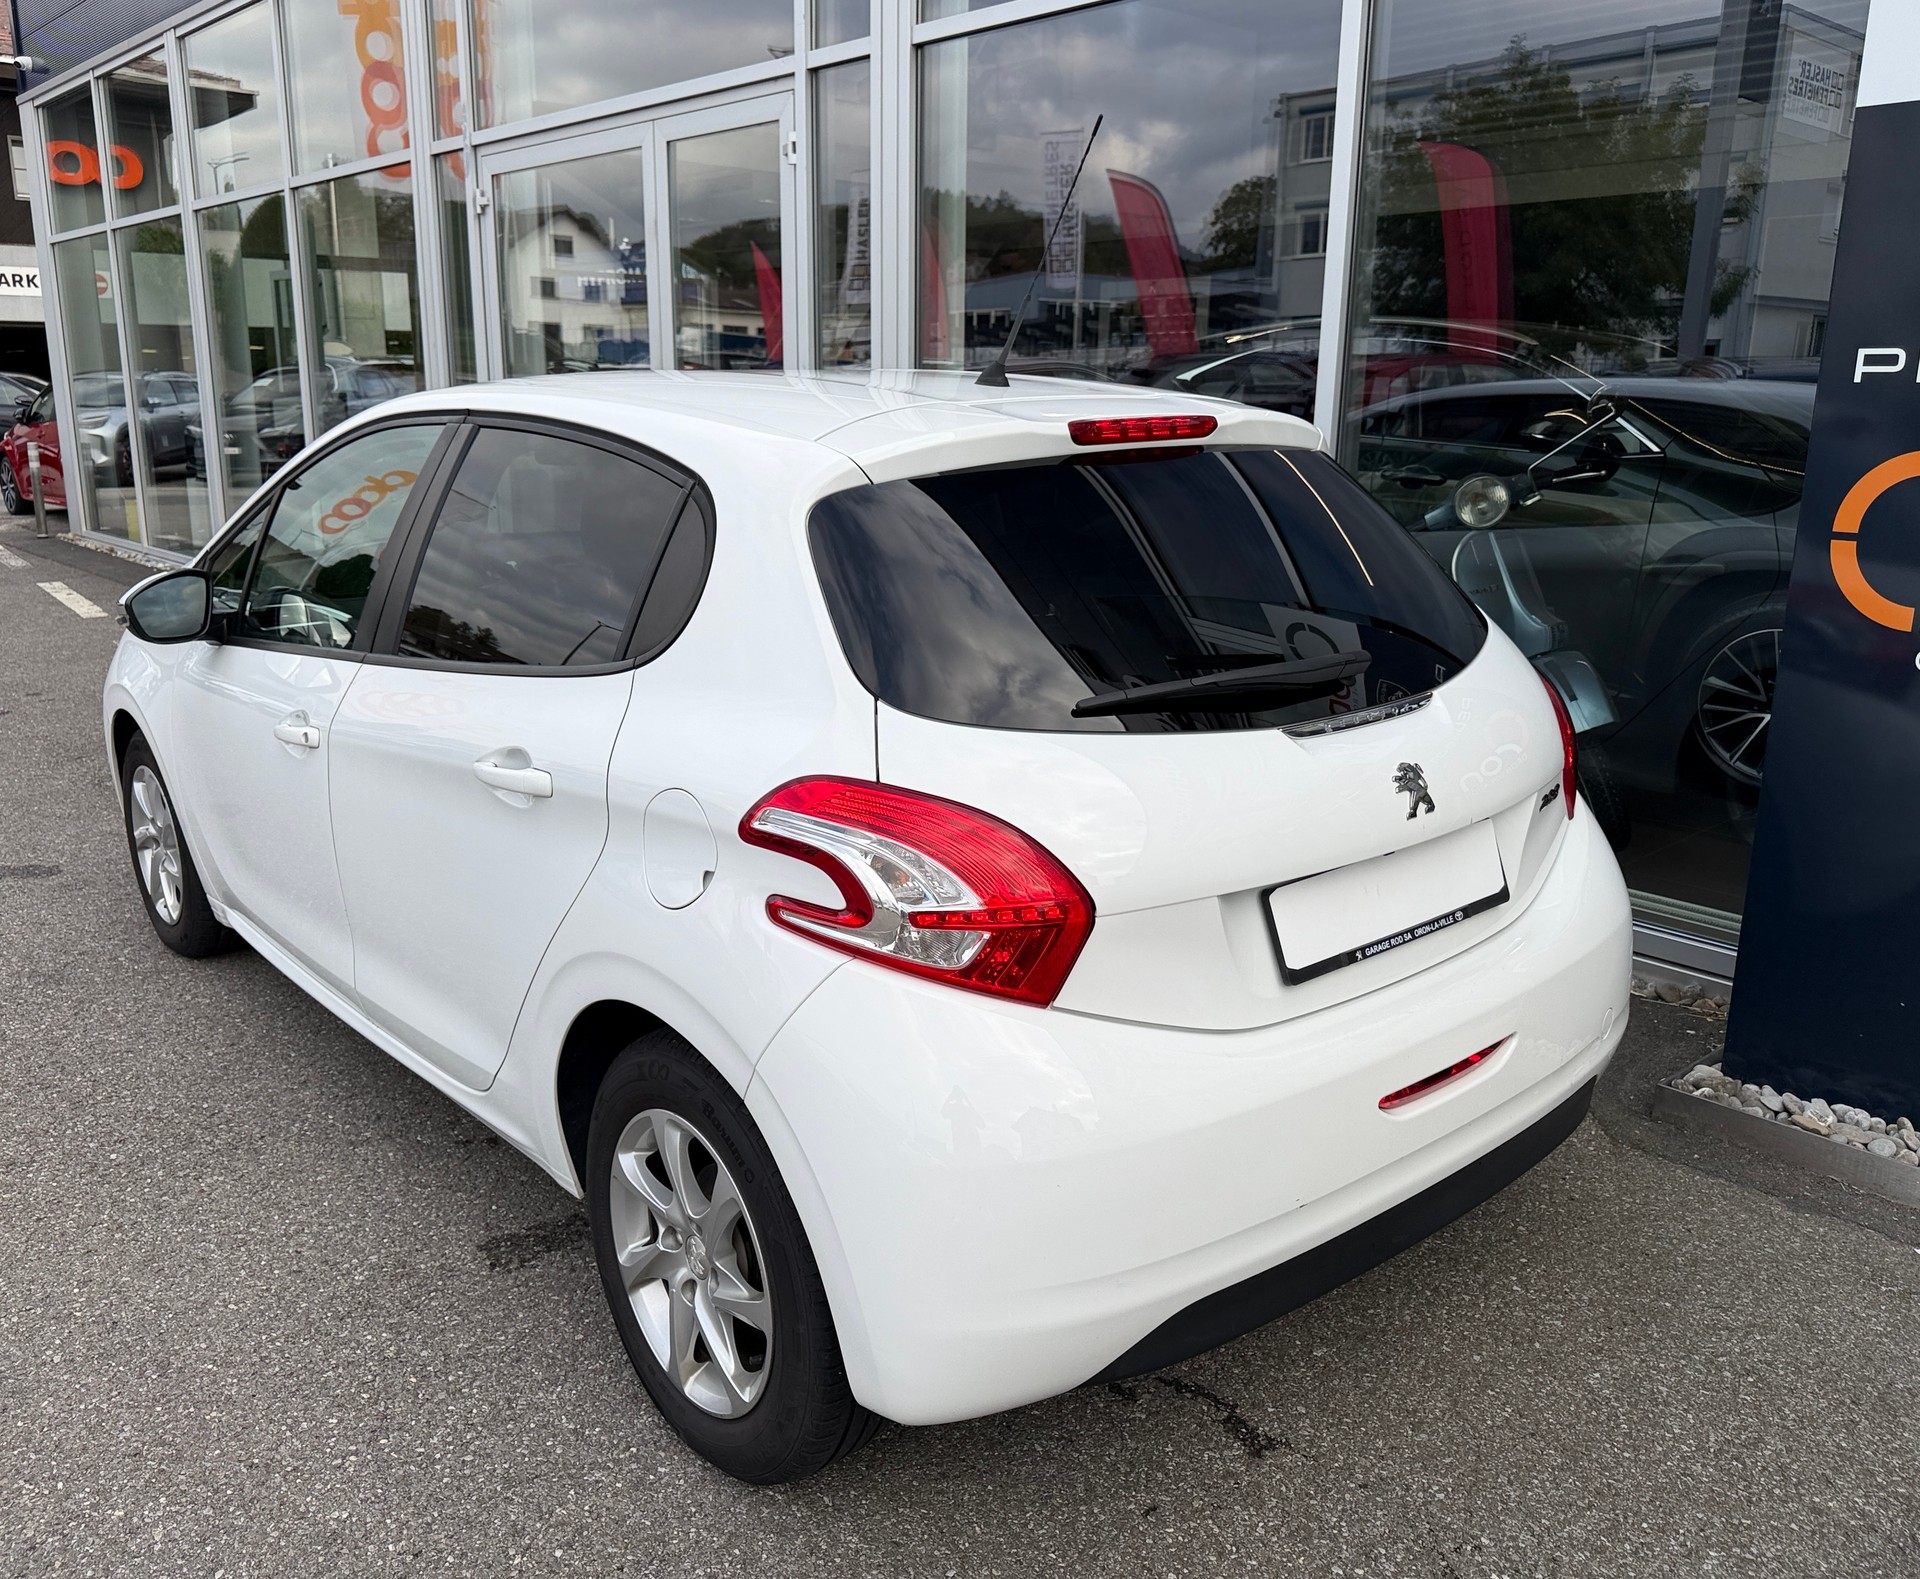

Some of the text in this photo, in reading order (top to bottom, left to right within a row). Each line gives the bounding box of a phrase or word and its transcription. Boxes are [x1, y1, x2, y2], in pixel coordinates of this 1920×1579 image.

[0, 272, 39, 289] ARK
[1853, 347, 1920, 383] P
[1365, 915, 1455, 956] GARAGE ROD SA ORON-LA-VILLE
